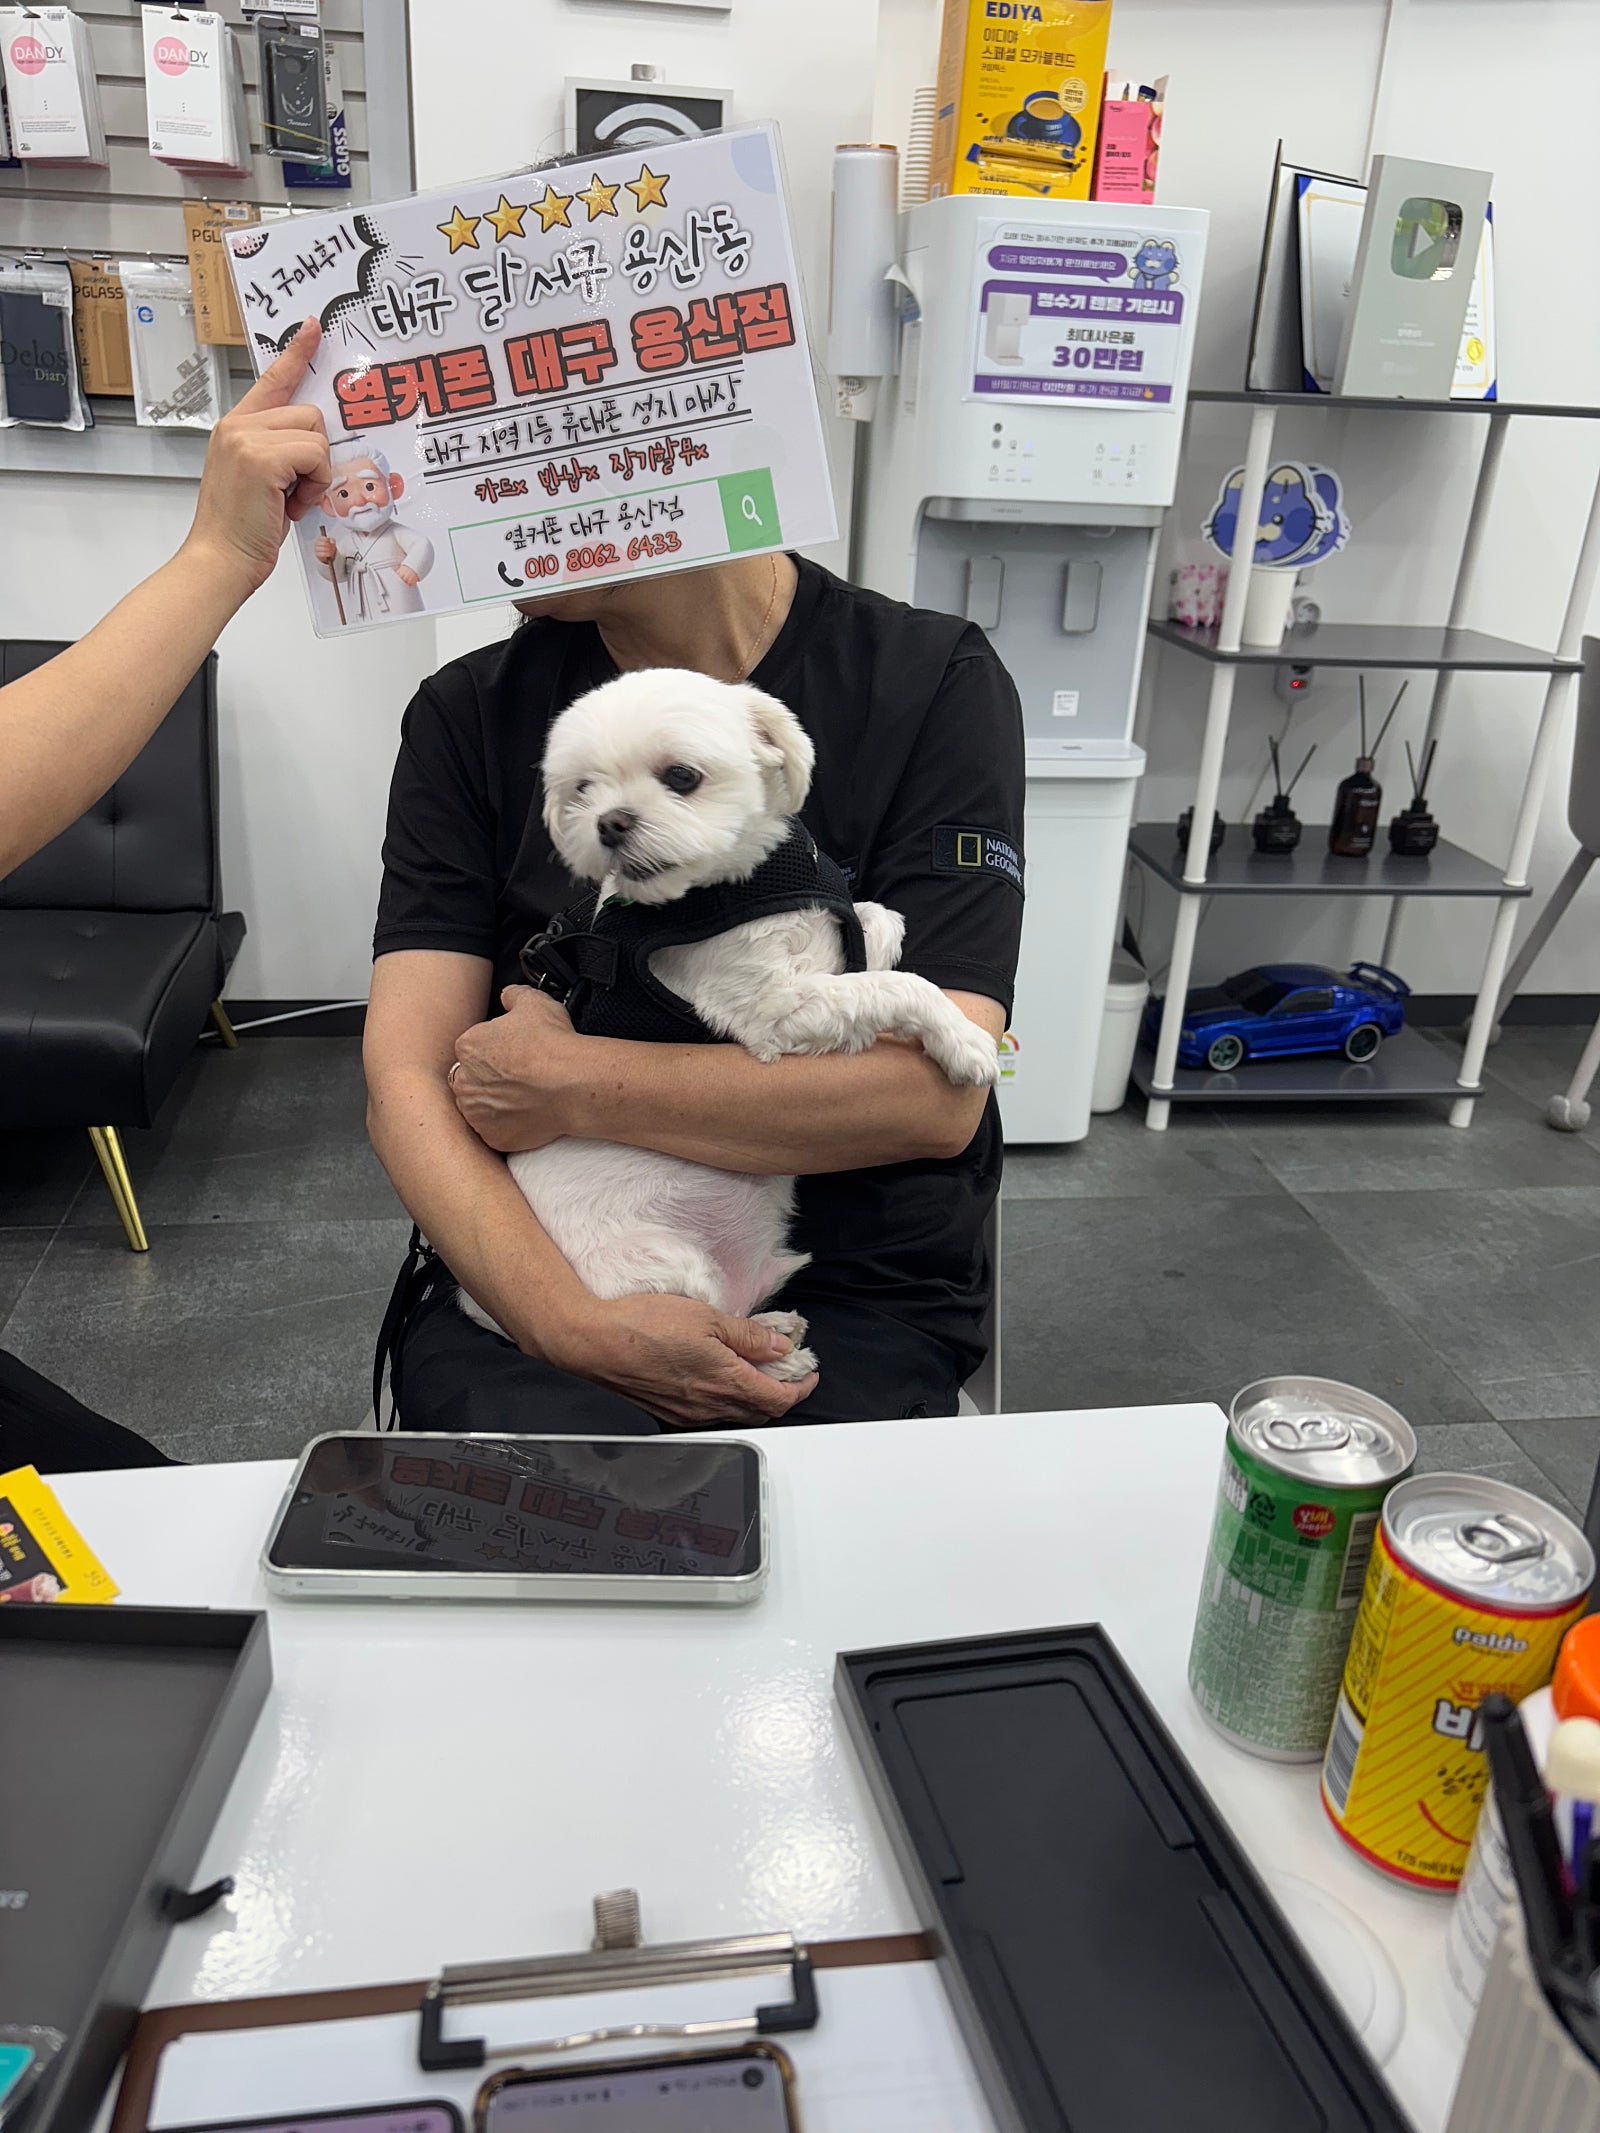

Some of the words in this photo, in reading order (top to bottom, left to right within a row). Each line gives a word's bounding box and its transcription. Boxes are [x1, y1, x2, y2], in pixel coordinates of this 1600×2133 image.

[983, 28, 1018, 44] 이디야
[15, 47, 63, 59] DANDY
[158, 47, 208, 63] DANDY
[981, 46, 1016, 62] 스페셜
[1020, 49, 1076, 68] 모카블렌드
[333, 127, 350, 176] GLASS
[192, 229, 223, 244] PGL
[244, 281, 281, 319] 실
[273, 224, 356, 296] 구매후기
[371, 284, 453, 336] 대구
[464, 244, 608, 327] 달서구
[625, 210, 748, 290] 용산동
[74, 285, 124, 300] PGLASS
[1036, 292, 1087, 311] 정수기
[1125, 298, 1175, 316] 가입시
[1066, 327, 1136, 345] 최대사은품
[333, 344, 497, 431] 옆커폰
[504, 318, 618, 398] 대구
[630, 283, 796, 373] 용산점
[1052, 345, 1145, 373] 30만원
[34, 369, 68, 386] Diary
[425, 433, 470, 465] 대구
[480, 420, 520, 455] 지역
[562, 399, 623, 442] 휴대폰
[632, 389, 678, 426] 성지
[686, 375, 742, 413] 매장
[505, 516, 563, 551] 옆커폰
[570, 510, 610, 537] 대구
[617, 495, 684, 532] 용산점
[525, 554, 559, 580] 010
[566, 543, 621, 573] 8062
[627, 531, 682, 561] 6433
[1452, 1626, 1529, 1653] paldo
